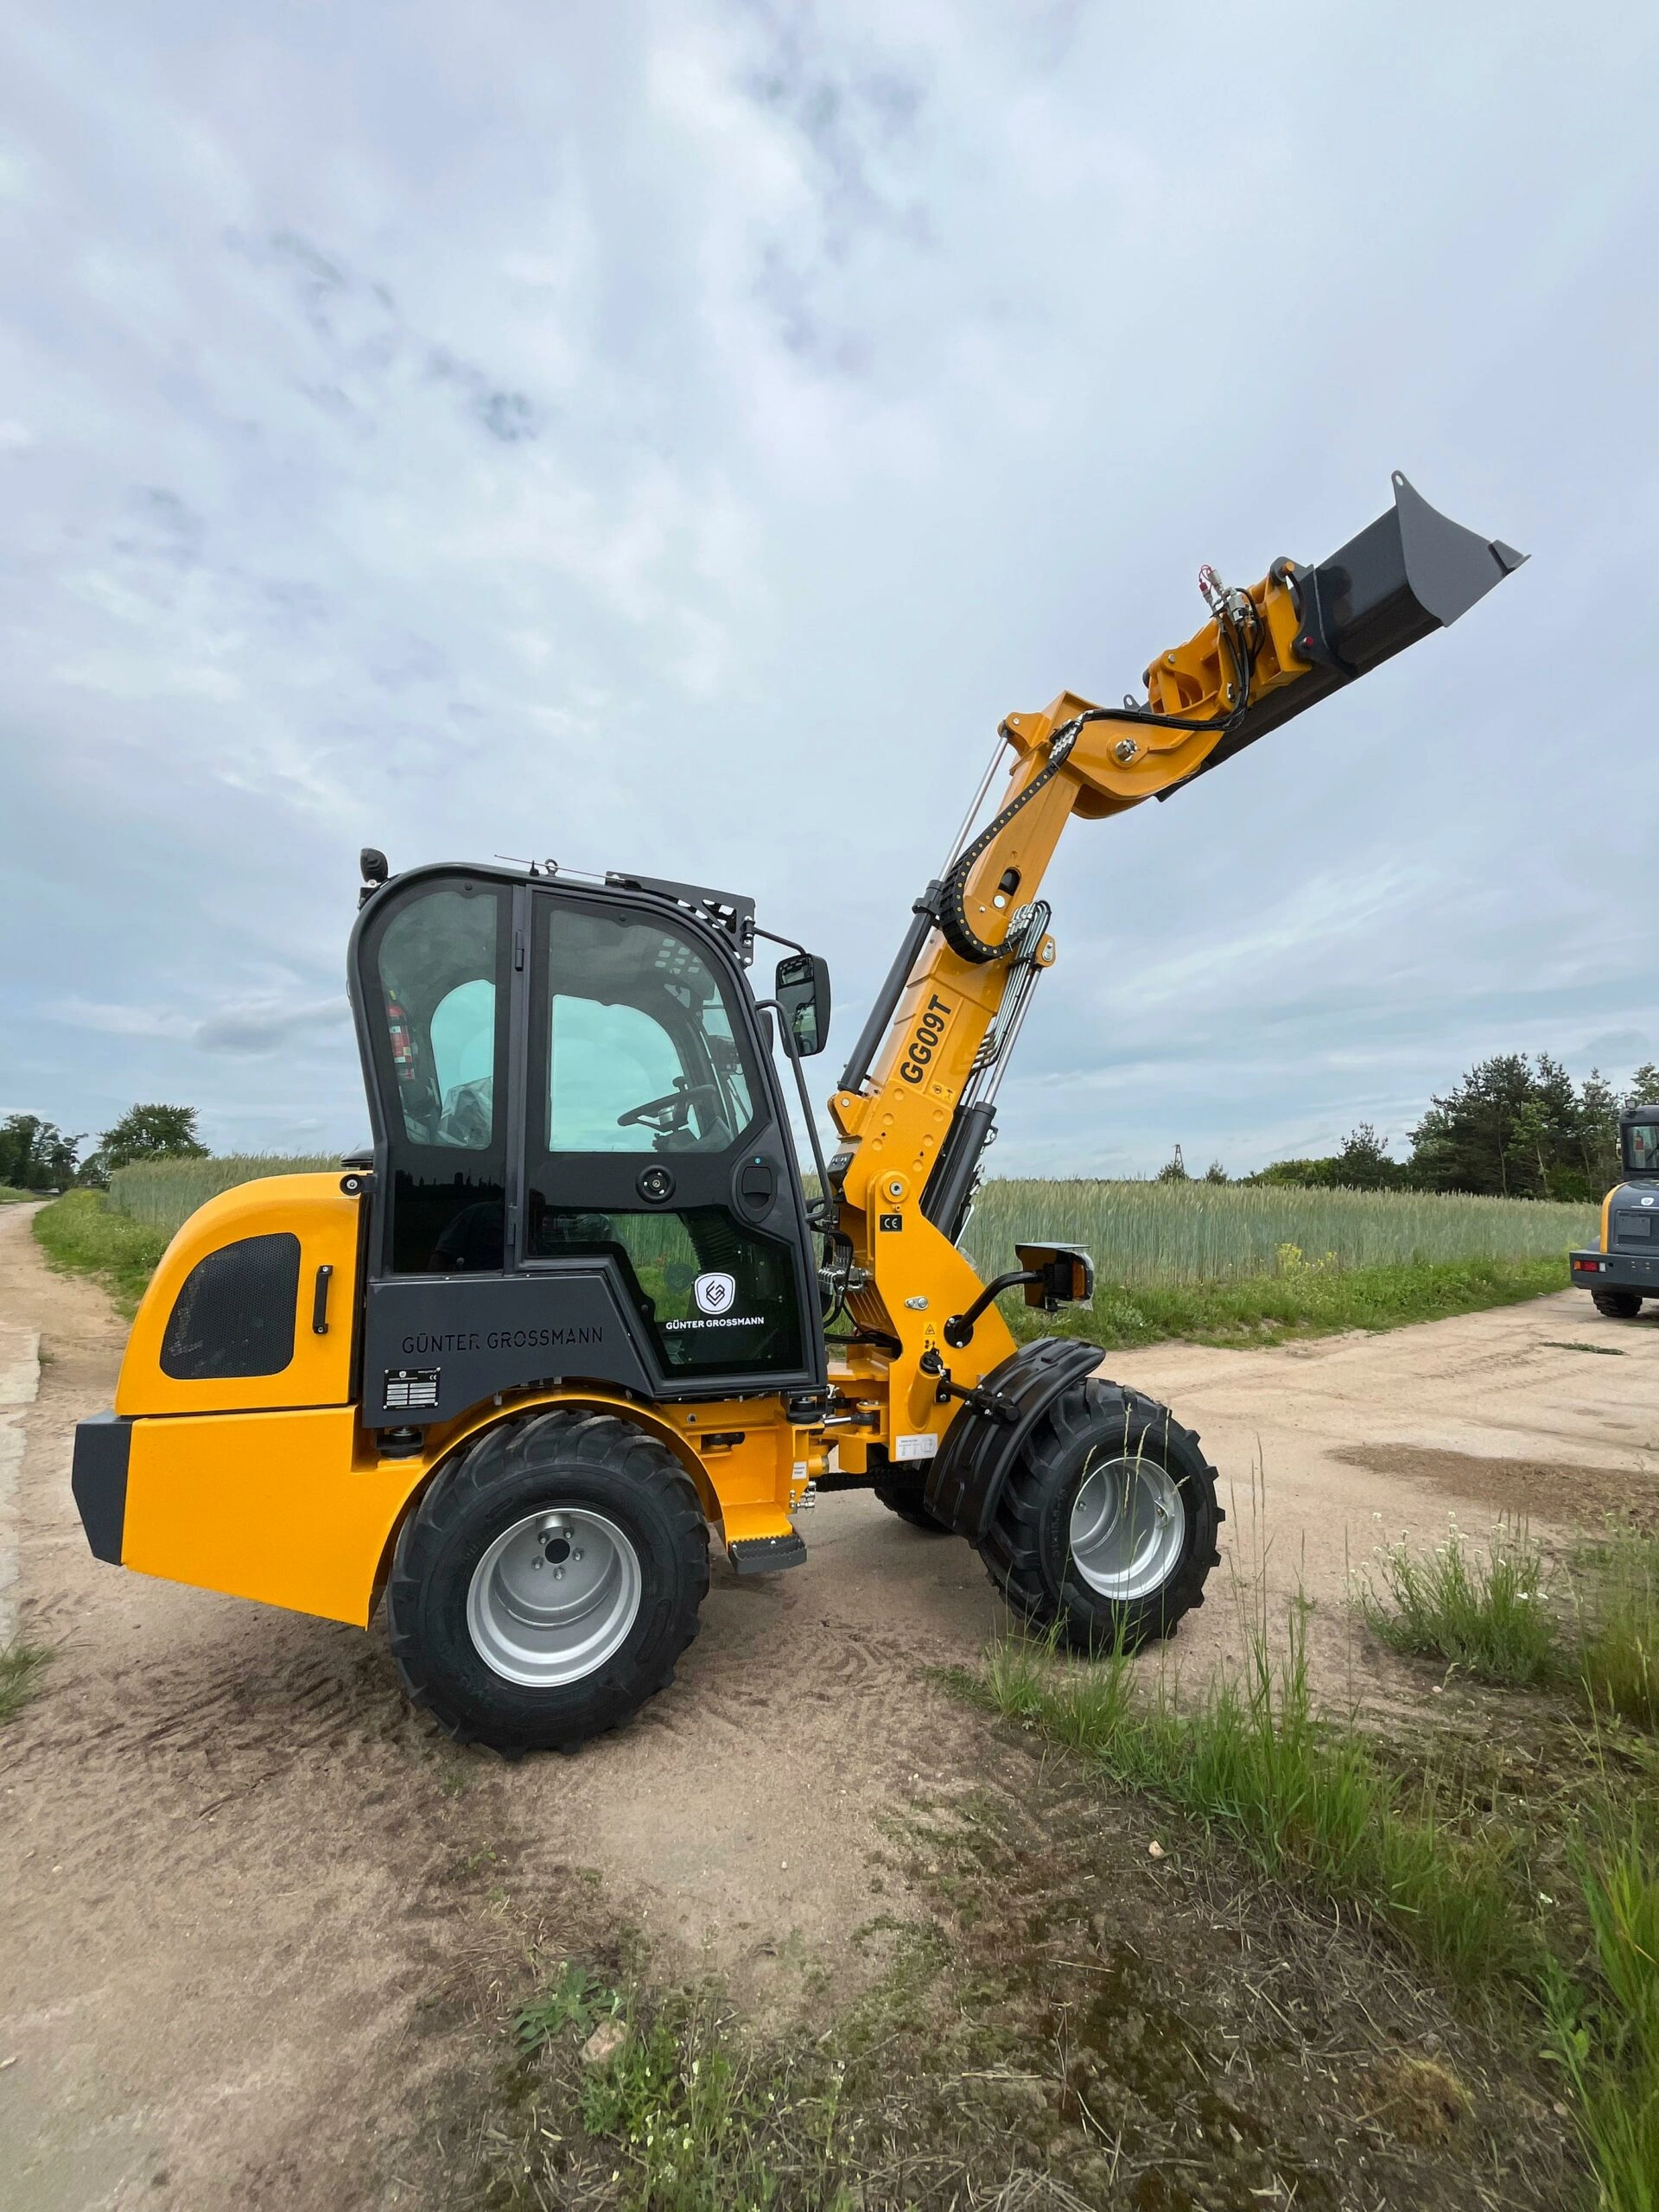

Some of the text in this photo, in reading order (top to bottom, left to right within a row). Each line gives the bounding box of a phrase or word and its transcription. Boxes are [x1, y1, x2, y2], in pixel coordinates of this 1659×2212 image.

[899, 994, 951, 1084] GG09T
[884, 1217, 898, 1229] CE
[666, 1317, 765, 1330] GÜNTER GROSSMANN
[402, 1326, 603, 1354] GÜNTER GROSSMANN
